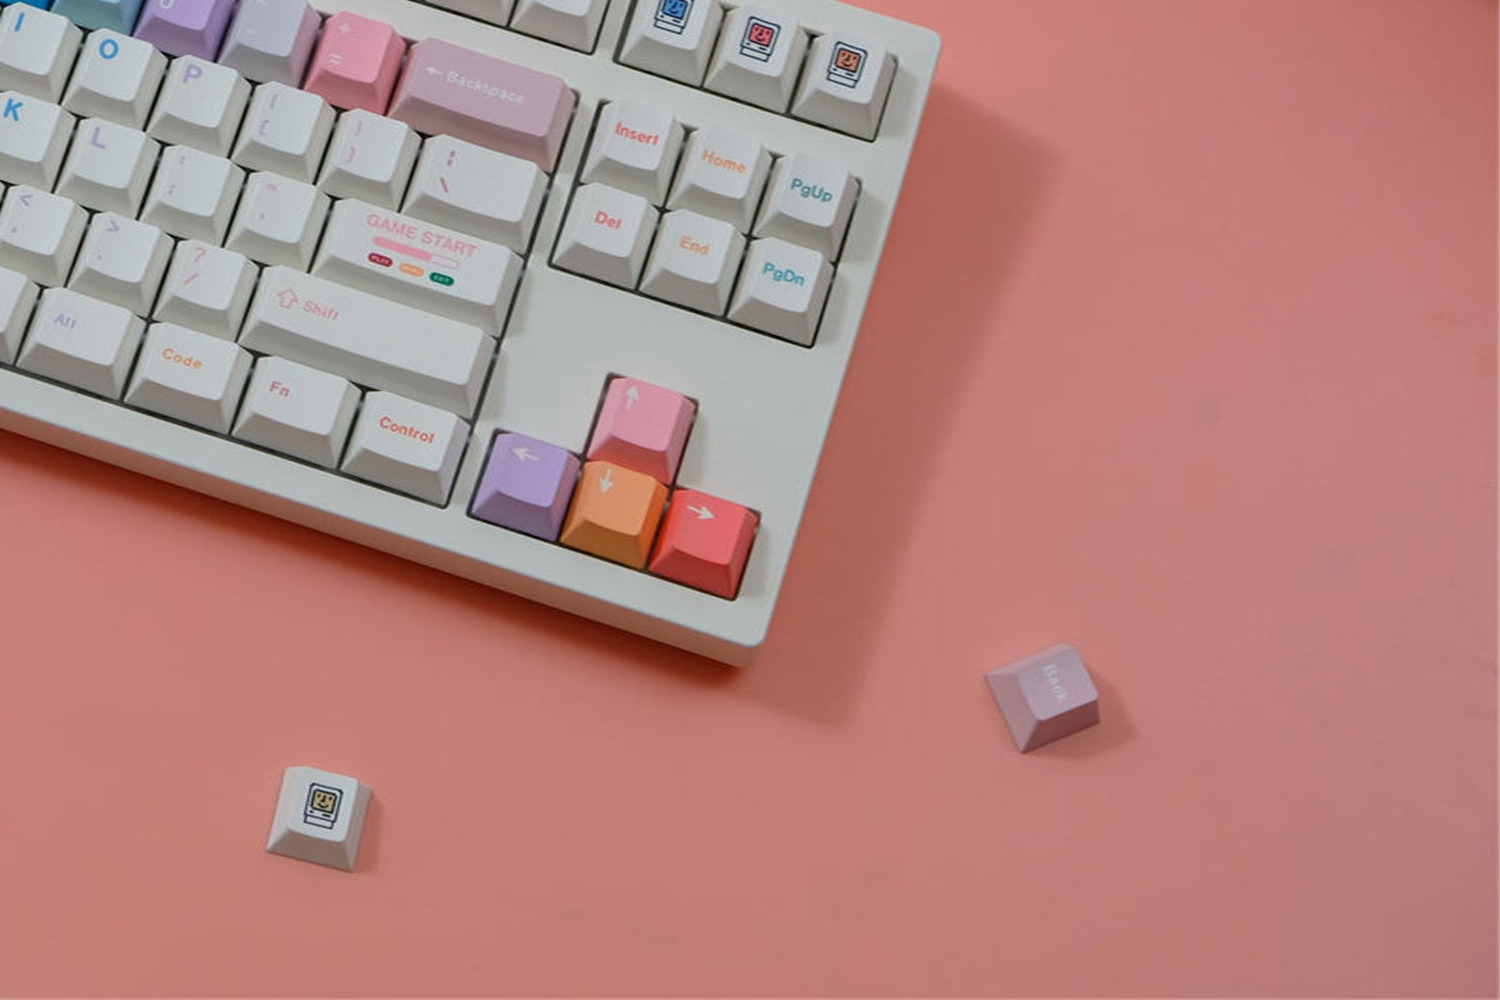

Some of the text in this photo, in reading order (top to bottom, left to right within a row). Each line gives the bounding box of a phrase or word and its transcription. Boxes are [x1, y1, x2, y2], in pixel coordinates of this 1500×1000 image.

[13, 12, 26, 32] I
[98, 38, 120, 60] O
[182, 64, 203, 85] P
[3, 98, 24, 122] K
[90, 127, 106, 150] L
[615, 122, 660, 147] Insert
[702, 149, 747, 175] Home
[790, 177, 833, 204] PgUp
[594, 210, 623, 230] Del
[366, 213, 478, 258] GAME START
[679, 236, 711, 256] End
[762, 262, 805, 288] PgDn
[53, 312, 76, 330] Alt
[303, 300, 341, 322] Shift
[162, 347, 203, 370] Code
[269, 379, 291, 398] Fn
[379, 415, 436, 445] Control
